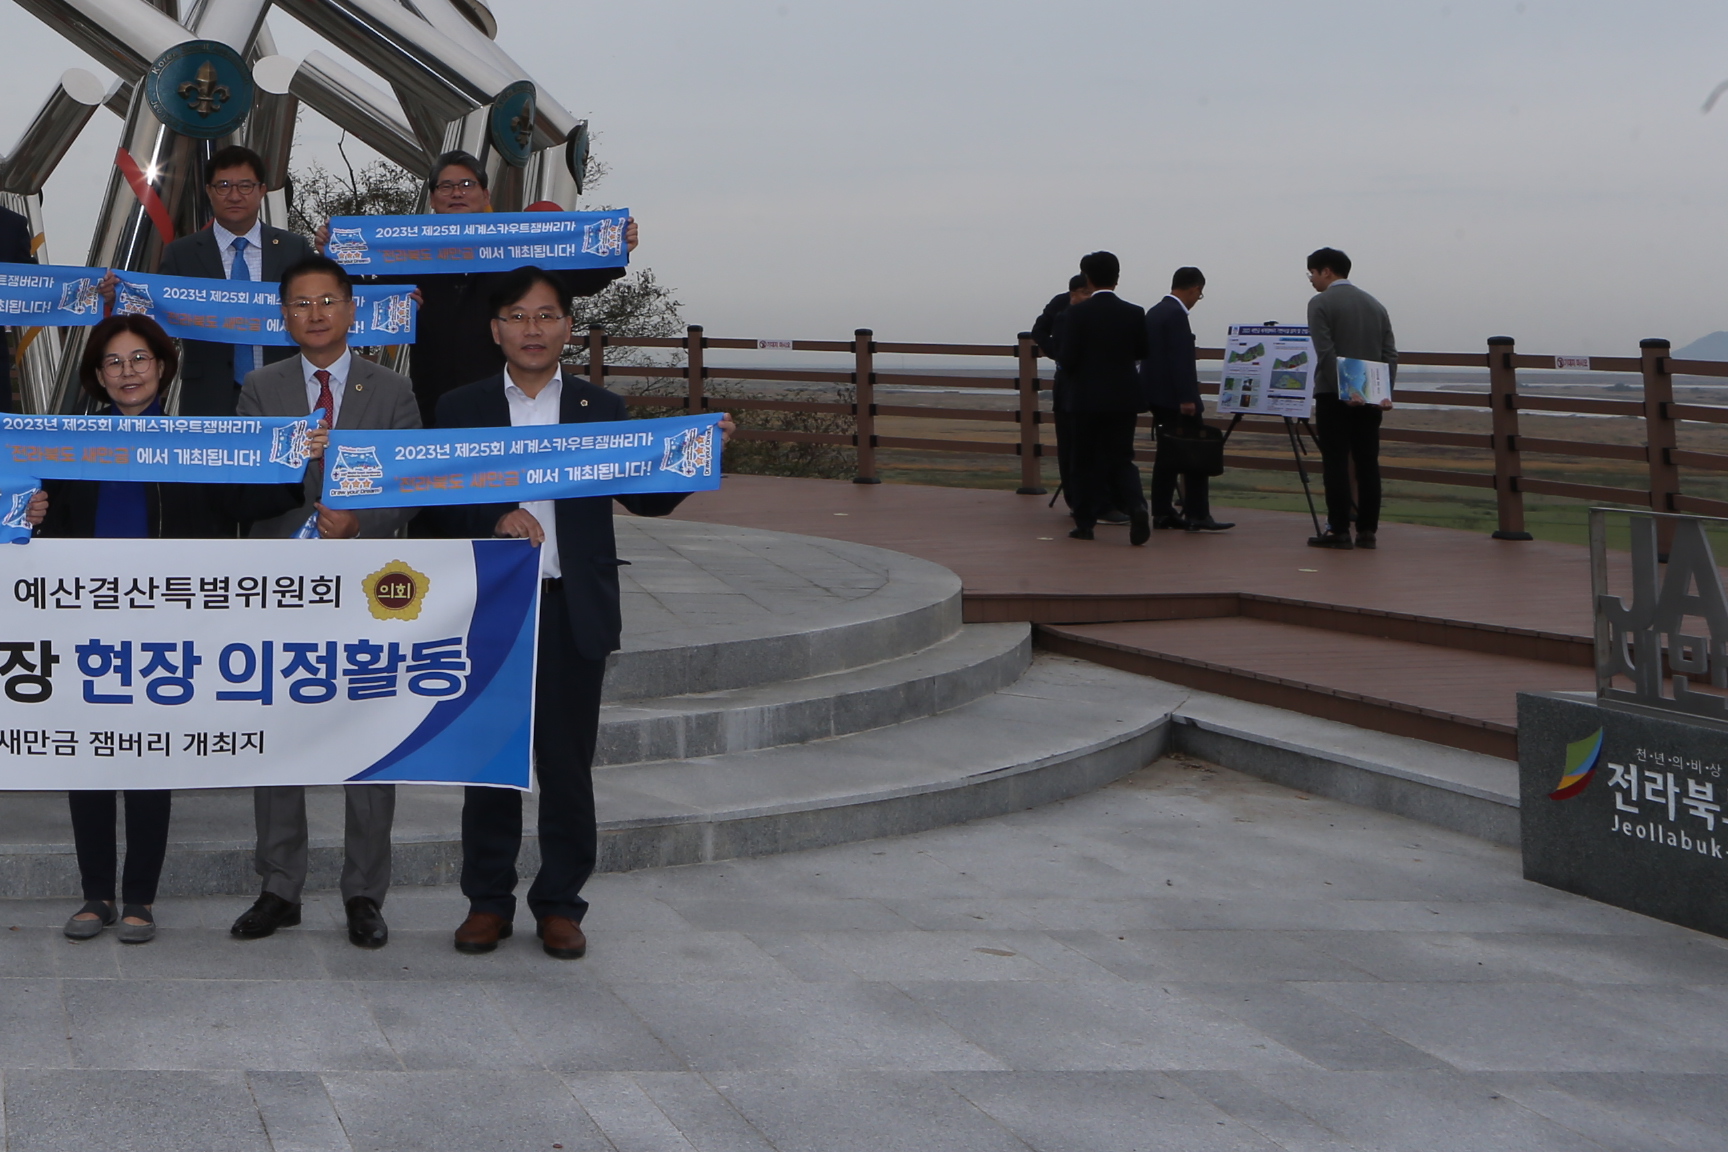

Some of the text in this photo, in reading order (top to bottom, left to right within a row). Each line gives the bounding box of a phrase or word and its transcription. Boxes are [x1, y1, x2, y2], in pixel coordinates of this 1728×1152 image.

[375, 221, 577, 238] 2023년 제25회 세계스카우트잼버리가
[508, 243, 576, 259] 개최됩니다!
[163, 286, 207, 302] 2023년
[209, 290, 250, 304] 제25회
[2, 417, 262, 434] 2023년 제25회 세계스카우트잼버리가
[394, 431, 654, 461] 2023년 제25회 세계스카우트잼버리가
[173, 447, 261, 467] 개최됩니다!
[564, 460, 652, 482] 개최됩니다!
[13, 574, 342, 610] 예산결산특별위원회
[376, 582, 414, 602] 의회
[74, 638, 203, 706] 현장
[215, 636, 468, 706] 의정활동
[88, 730, 171, 758] 잼버리
[182, 729, 265, 757] 개최지
[1607, 762, 1728, 832] 전라북
